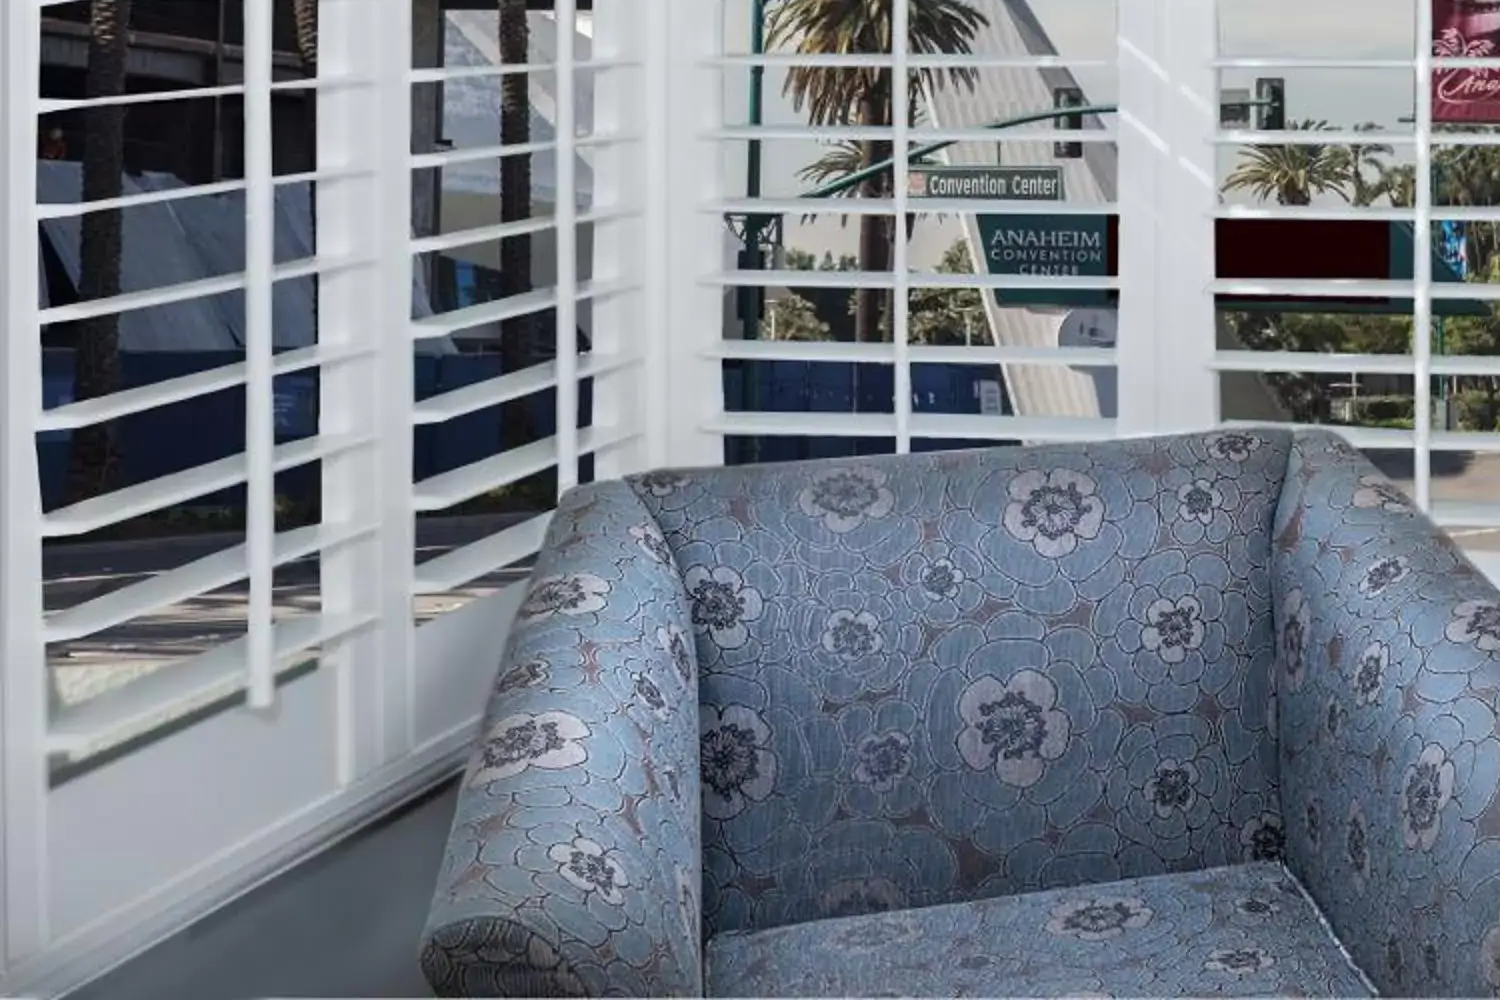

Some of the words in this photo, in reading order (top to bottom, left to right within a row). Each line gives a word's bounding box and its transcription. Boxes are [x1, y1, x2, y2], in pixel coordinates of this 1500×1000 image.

[929, 173, 1007, 195] Convention
[1012, 175, 1057, 195] Center
[991, 230, 1101, 247] ANAHEIM
[991, 248, 1102, 262] CONVENTION
